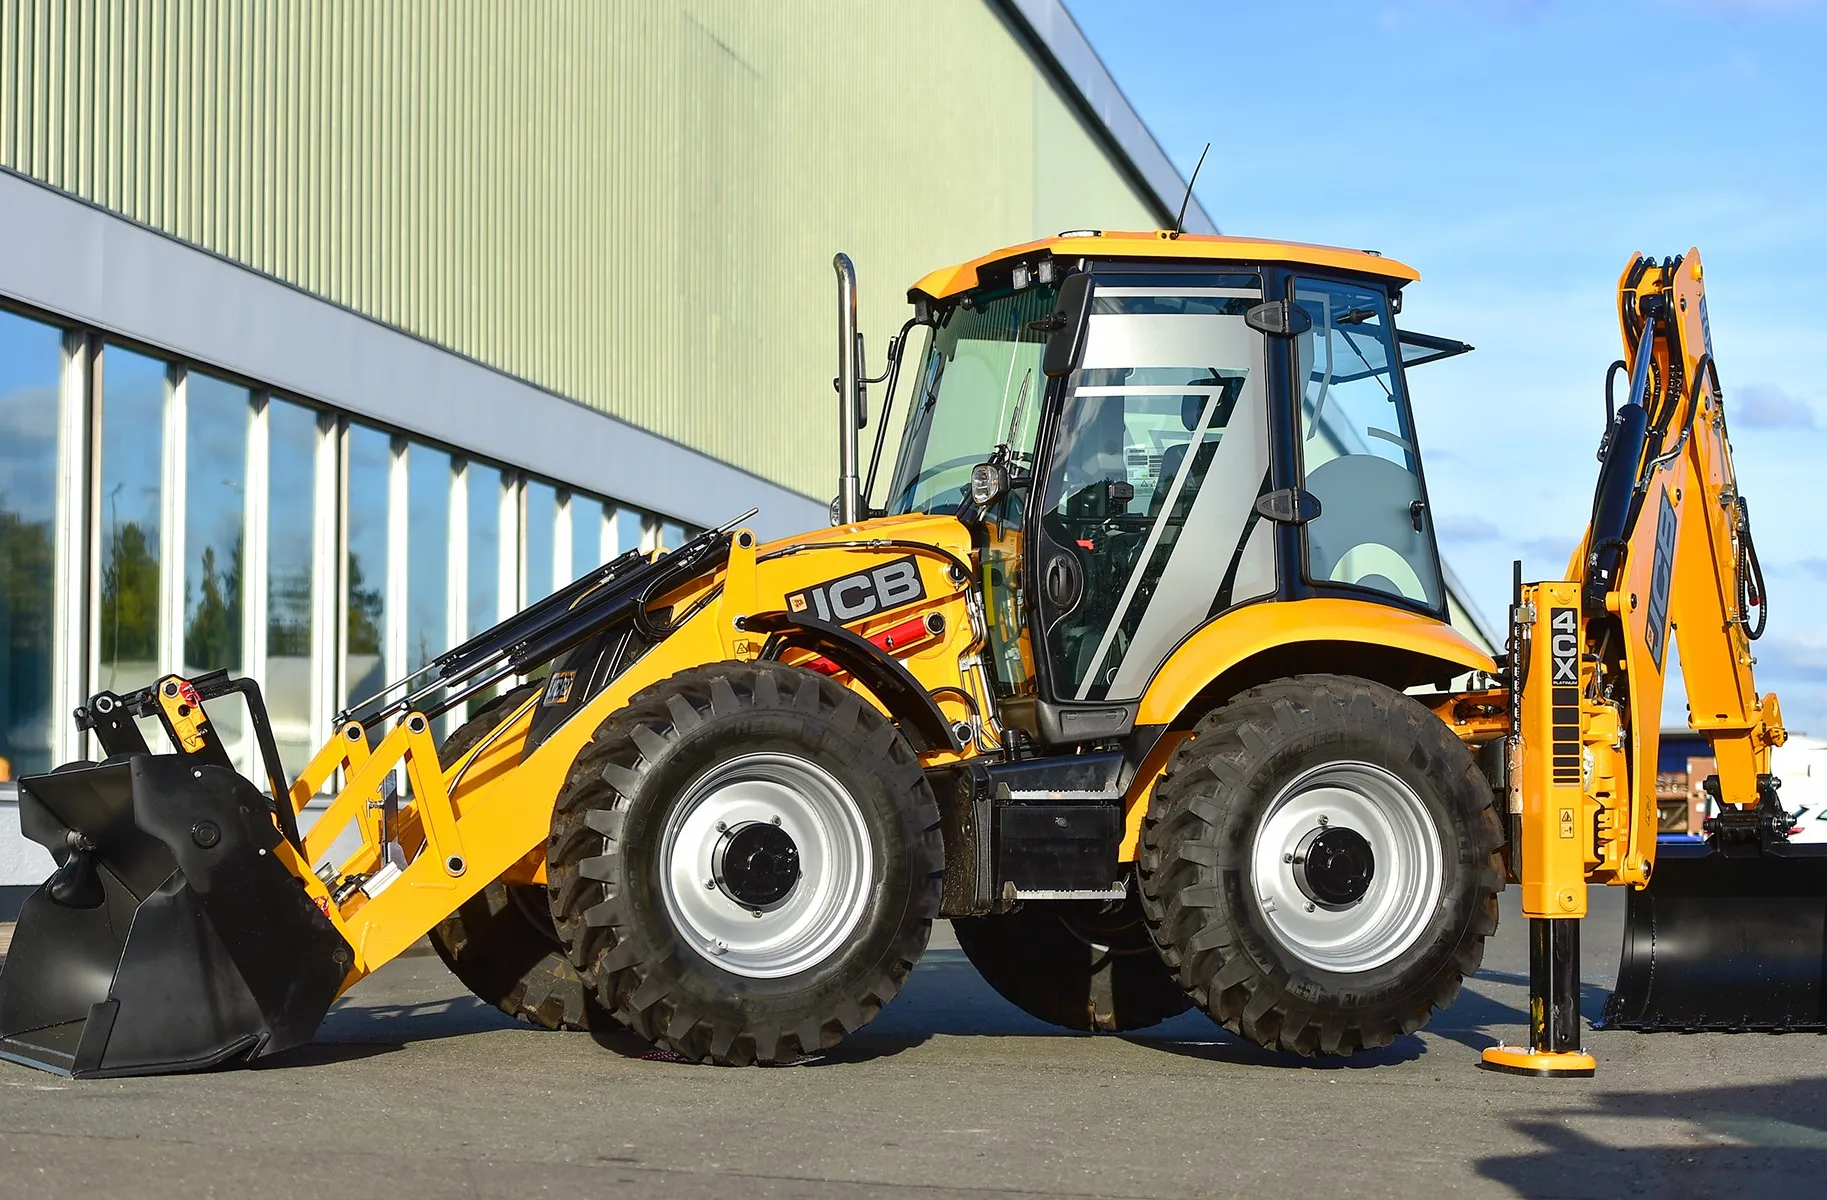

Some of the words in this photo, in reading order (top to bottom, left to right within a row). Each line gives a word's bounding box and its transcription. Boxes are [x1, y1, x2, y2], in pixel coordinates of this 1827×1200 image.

[811, 561, 922, 623] JCB
[1650, 495, 1676, 664] JCB
[1552, 610, 1577, 680] 4CX
